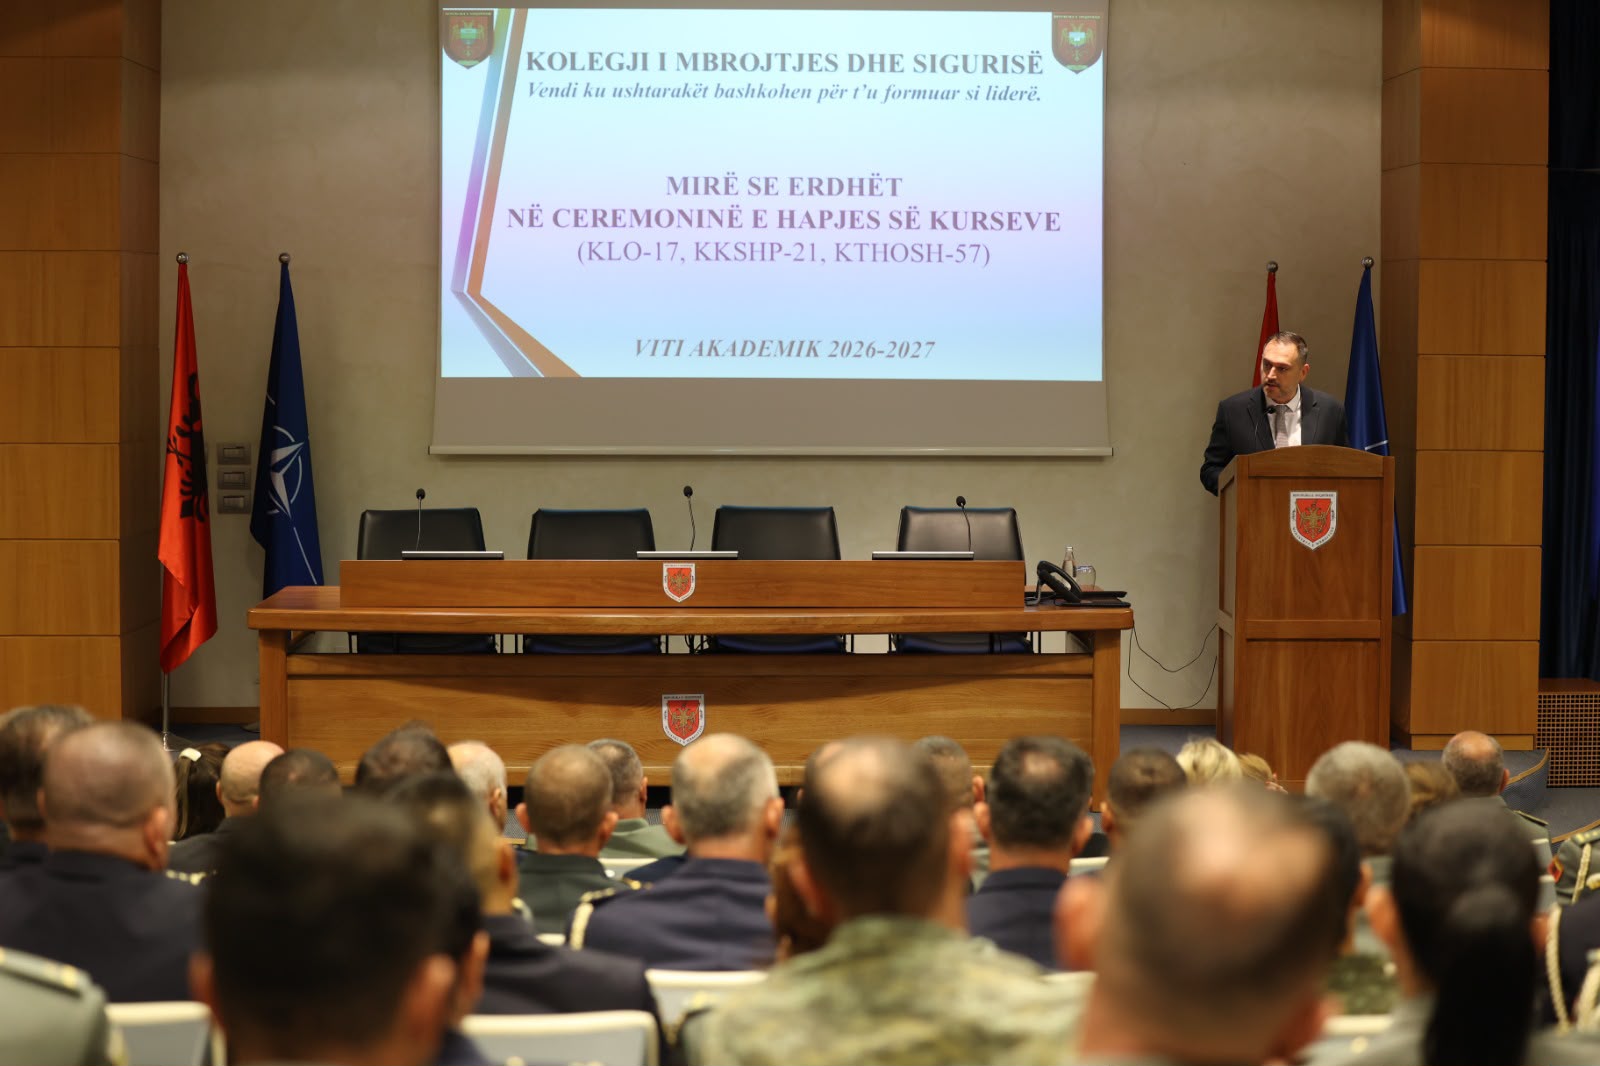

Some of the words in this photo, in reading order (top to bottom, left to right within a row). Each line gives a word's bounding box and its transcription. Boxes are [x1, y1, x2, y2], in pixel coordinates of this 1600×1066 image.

[526, 51, 649, 72] KOLEGJI
[658, 51, 667, 72] I
[676, 51, 839, 73] MBROJTJES
[847, 53, 905, 74] DHE
[913, 50, 1044, 75] SIGURISË
[528, 81, 579, 98] Vendi
[583, 82, 607, 99] ku
[612, 82, 709, 99] ushtarakët
[714, 82, 812, 100] bashkohen
[817, 84, 848, 104] për
[880, 84, 961, 105] formuar
[965, 85, 981, 101] si
[985, 85, 1041, 102] liderë.
[666, 171, 739, 196] MIRË
[747, 176, 780, 197] SE
[788, 172, 903, 197] ERDHËT
[507, 203, 544, 228] NË
[552, 203, 744, 229] CEREMONINË
[752, 209, 769, 229] E
[776, 209, 881, 230] HAPJES
[888, 205, 921, 231] SË
[930, 210, 1062, 232] KURSEVE
[577, 241, 686, 265] (KLO-17,
[694, 241, 826, 265] KKSHP-21,
[835, 242, 991, 267] KTHOSH-57)
[635, 339, 685, 358] VITI
[687, 339, 822, 358] AKADEMIK
[827, 340, 936, 359] 2026-2027
